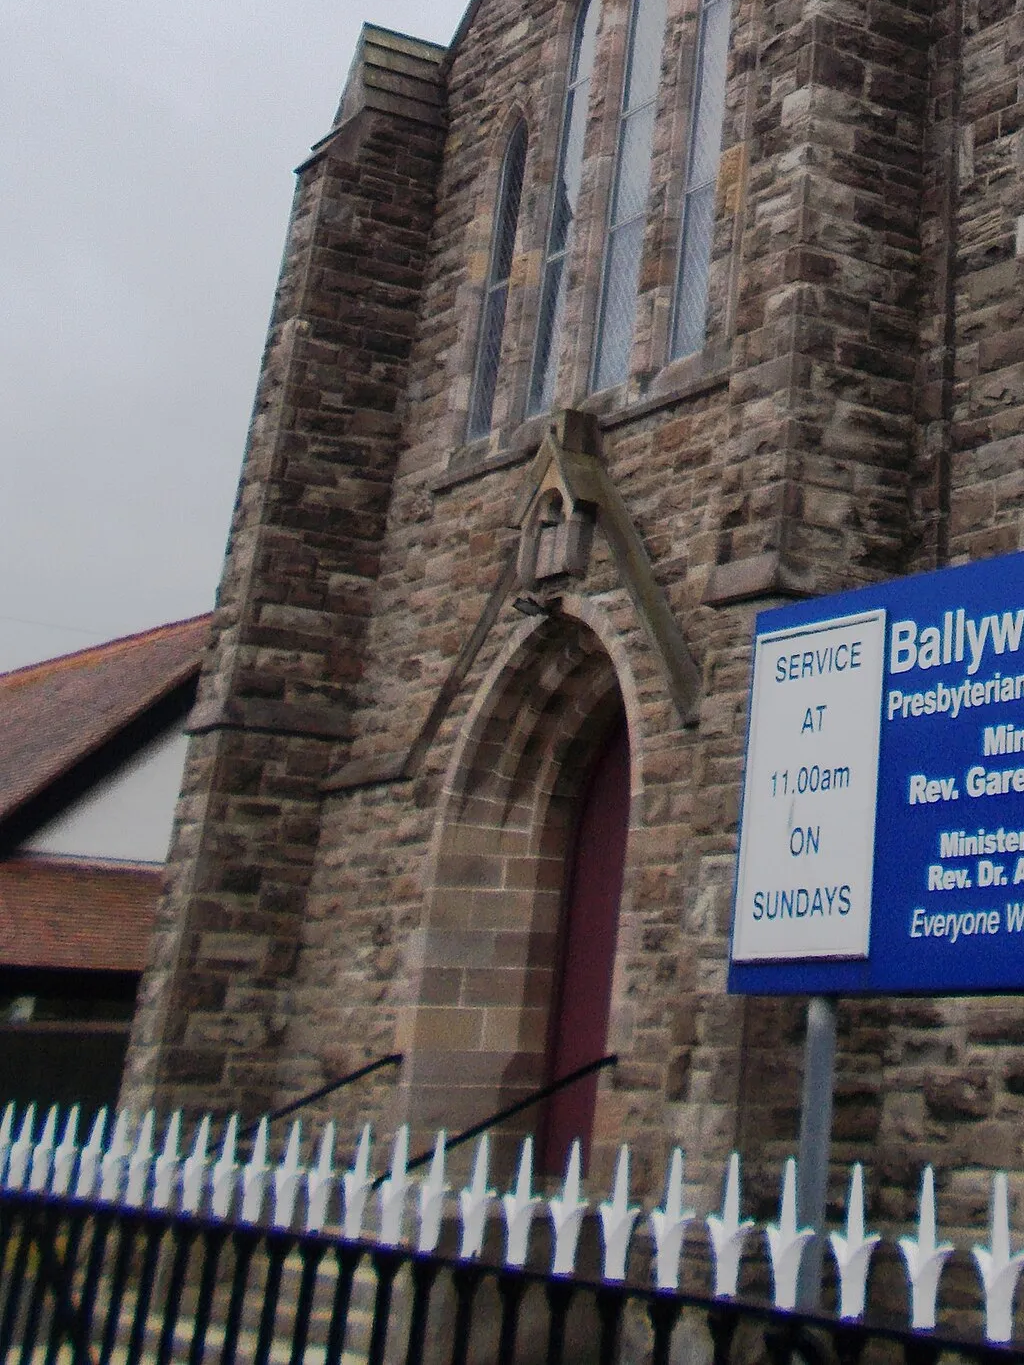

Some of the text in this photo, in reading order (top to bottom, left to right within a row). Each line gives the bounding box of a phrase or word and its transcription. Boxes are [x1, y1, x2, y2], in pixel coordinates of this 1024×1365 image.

[775, 641, 862, 683] SERVICE
[801, 704, 827, 734] AT
[771, 765, 851, 798] 11.00am
[909, 774, 959, 805] Rev.
[789, 826, 820, 856] ON
[928, 865, 972, 891] Rev.
[978, 860, 1008, 887] Dr.
[752, 884, 851, 922] SUNDAYS
[910, 908, 1000, 943] Everyone
